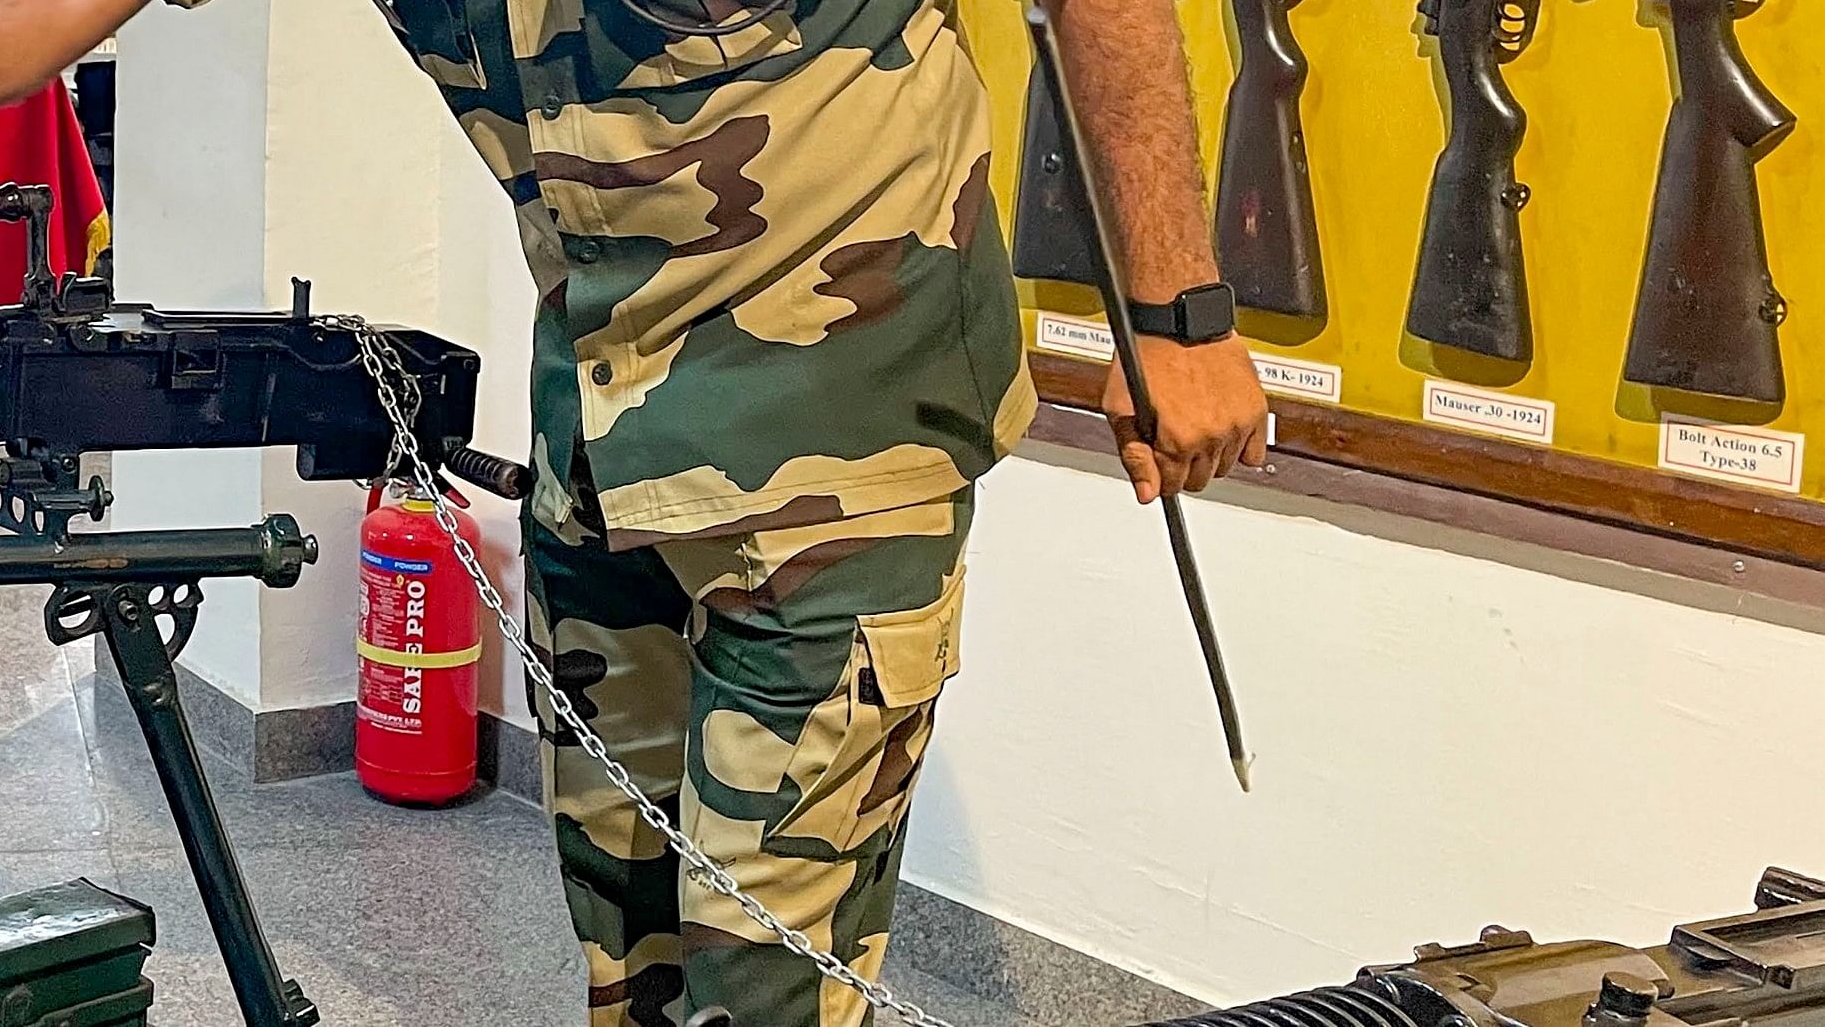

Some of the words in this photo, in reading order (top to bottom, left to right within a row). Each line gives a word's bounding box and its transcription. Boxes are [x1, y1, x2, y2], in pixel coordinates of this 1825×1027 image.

[1047, 324, 1066, 336] 7.62
[1068, 330, 1087, 341] mm
[1089, 332, 1111, 345] Mau
[1264, 367, 1278, 378] 98
[1299, 373, 1324, 387] 1924
[1435, 394, 1482, 413] Mauser
[1506, 409, 1542, 425] -1924
[1678, 428, 1707, 445] Bolt
[1710, 436, 1757, 454] Action
[1761, 444, 1783, 459] 6.5
[1700, 449, 1757, 472] Type-38
[406, 580, 426, 639] PRO
